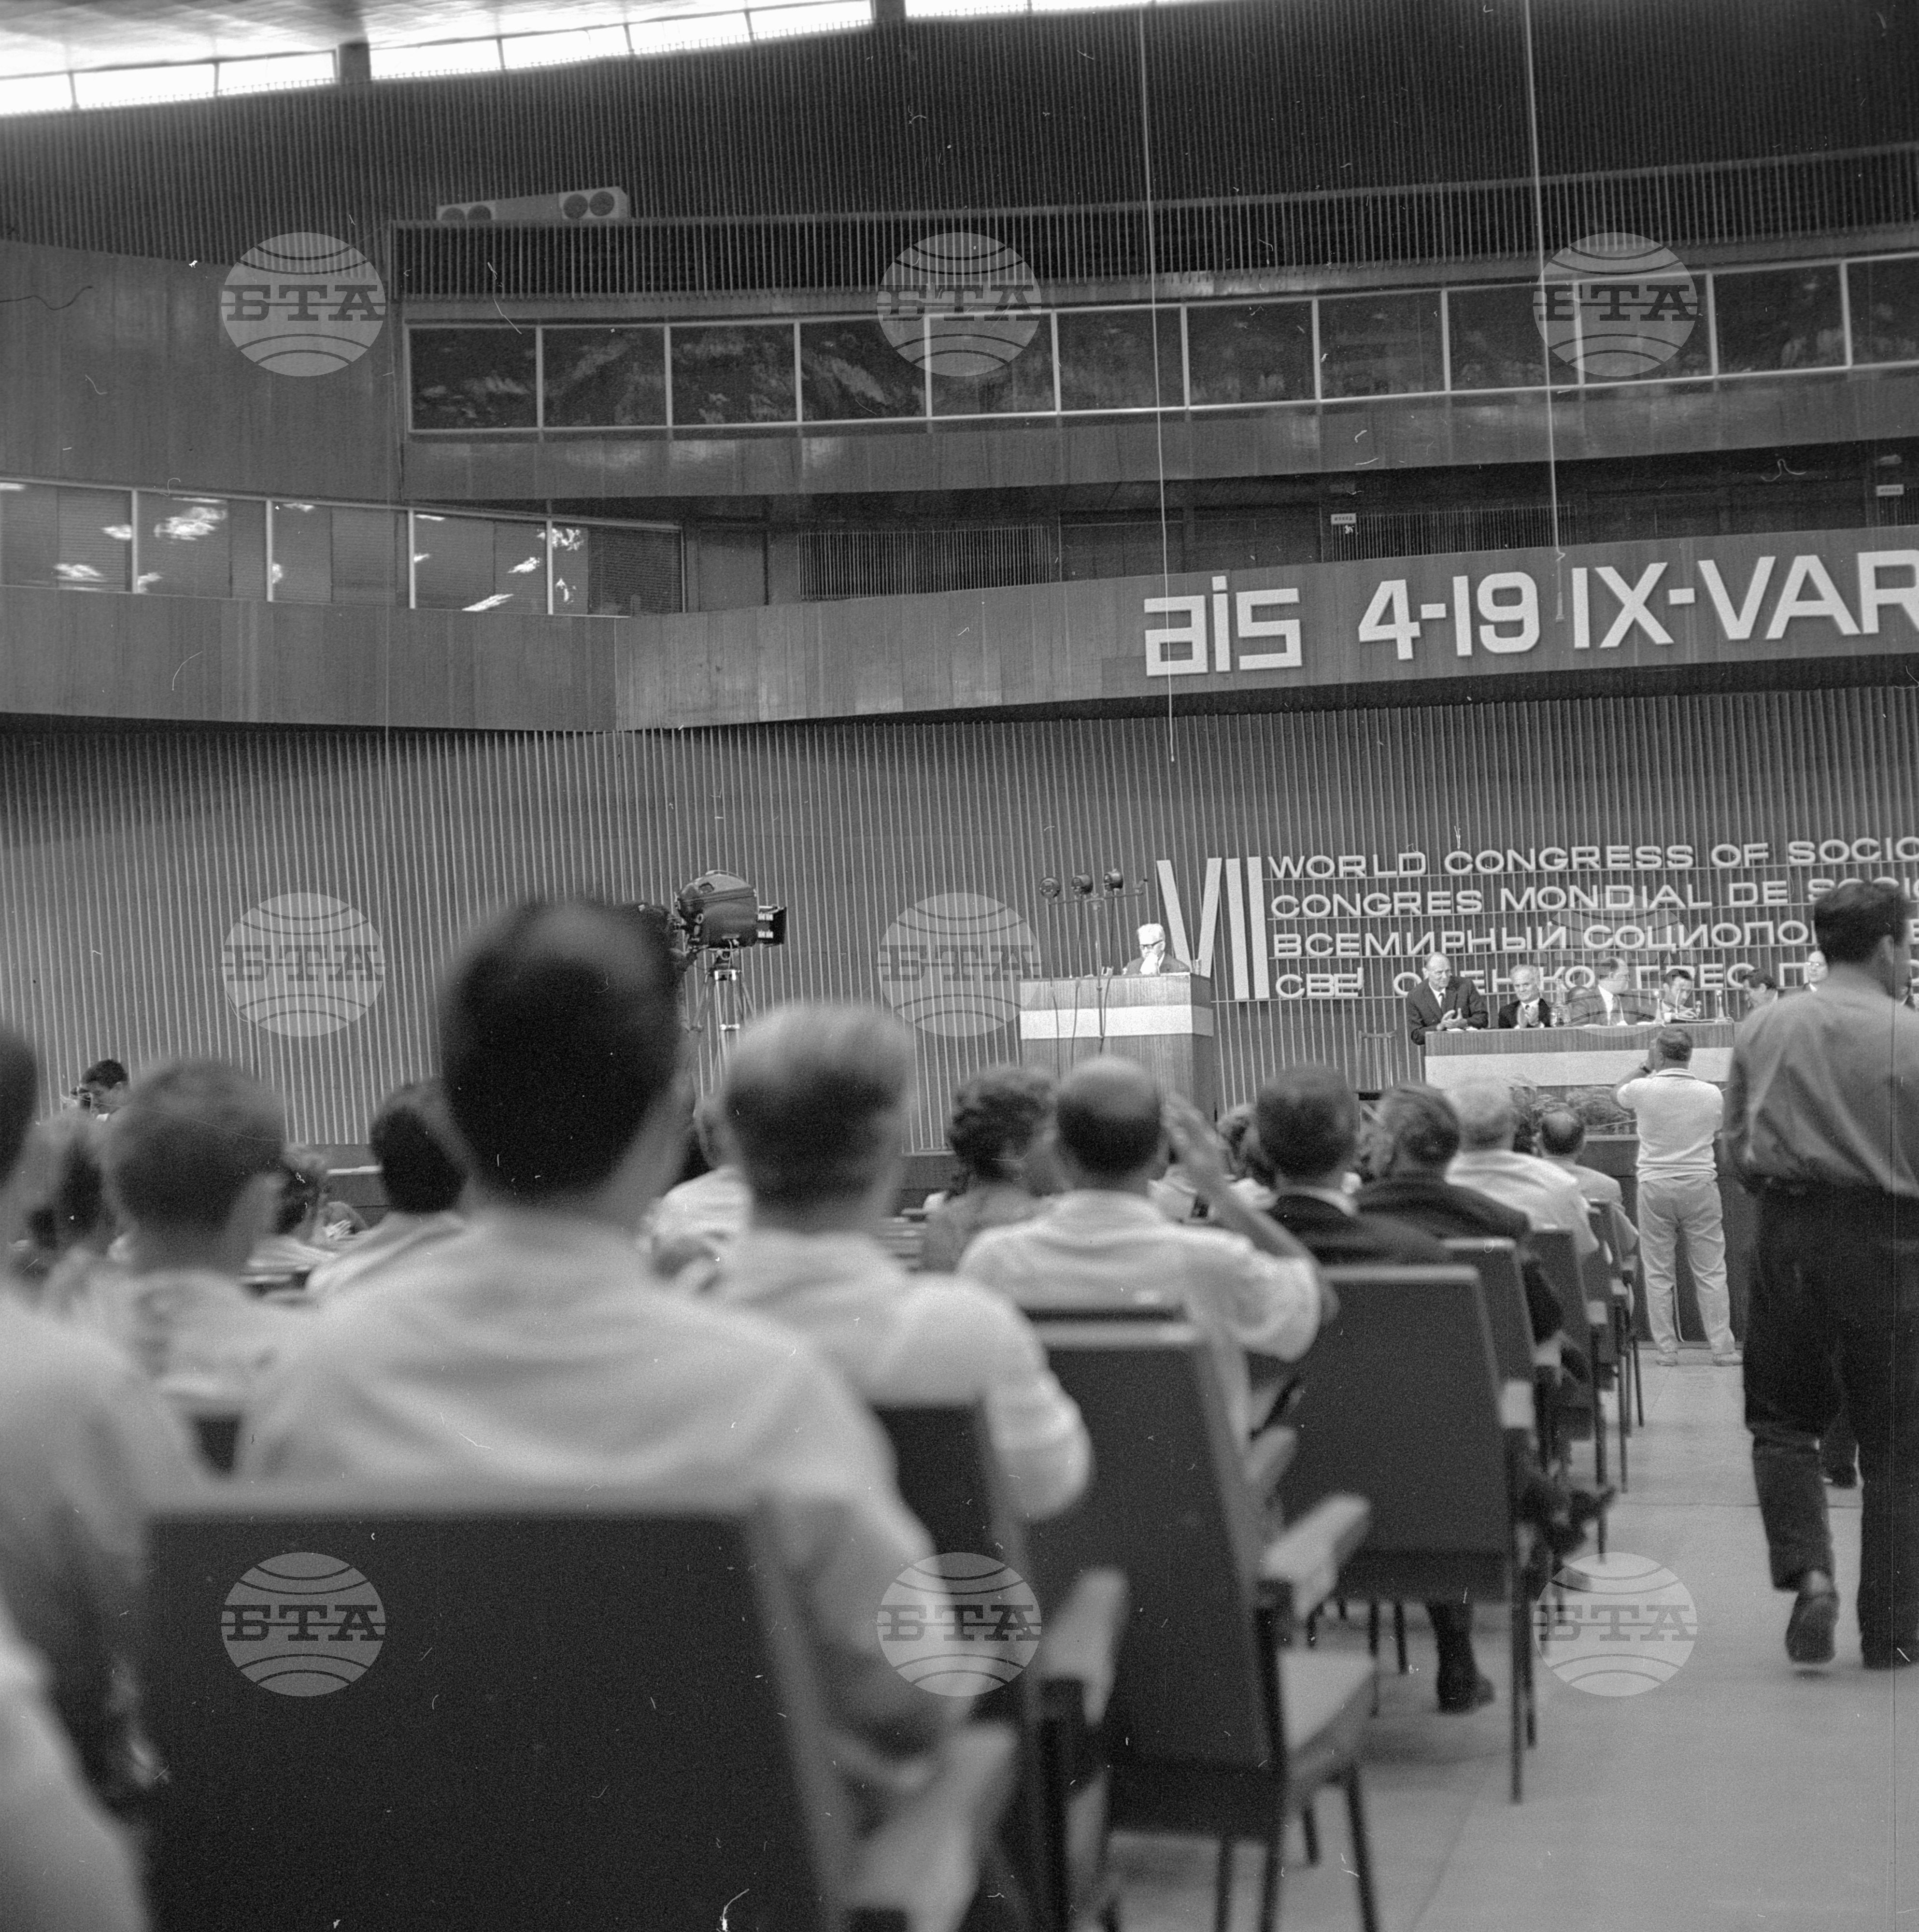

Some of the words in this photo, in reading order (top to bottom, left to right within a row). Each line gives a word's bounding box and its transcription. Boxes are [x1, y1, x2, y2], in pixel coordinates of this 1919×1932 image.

[1144, 575, 1303, 677] ais
[1358, 571, 1541, 660] 4-19
[1572, 549, 1919, 651] IX-VAR
[1267, 852, 1426, 878] WORLD
[1444, 844, 1694, 876] CONGRESS
[1711, 842, 1769, 868] OF
[1788, 837, 1919, 866] SOCIO
[1271, 890, 1483, 919] CONGRES
[1501, 883, 1712, 912] MONDIAL
[1729, 880, 1788, 906] DE
[1157, 857, 1270, 999] VII
[1274, 921, 1566, 957] ВСЕМИРНЫЙ
